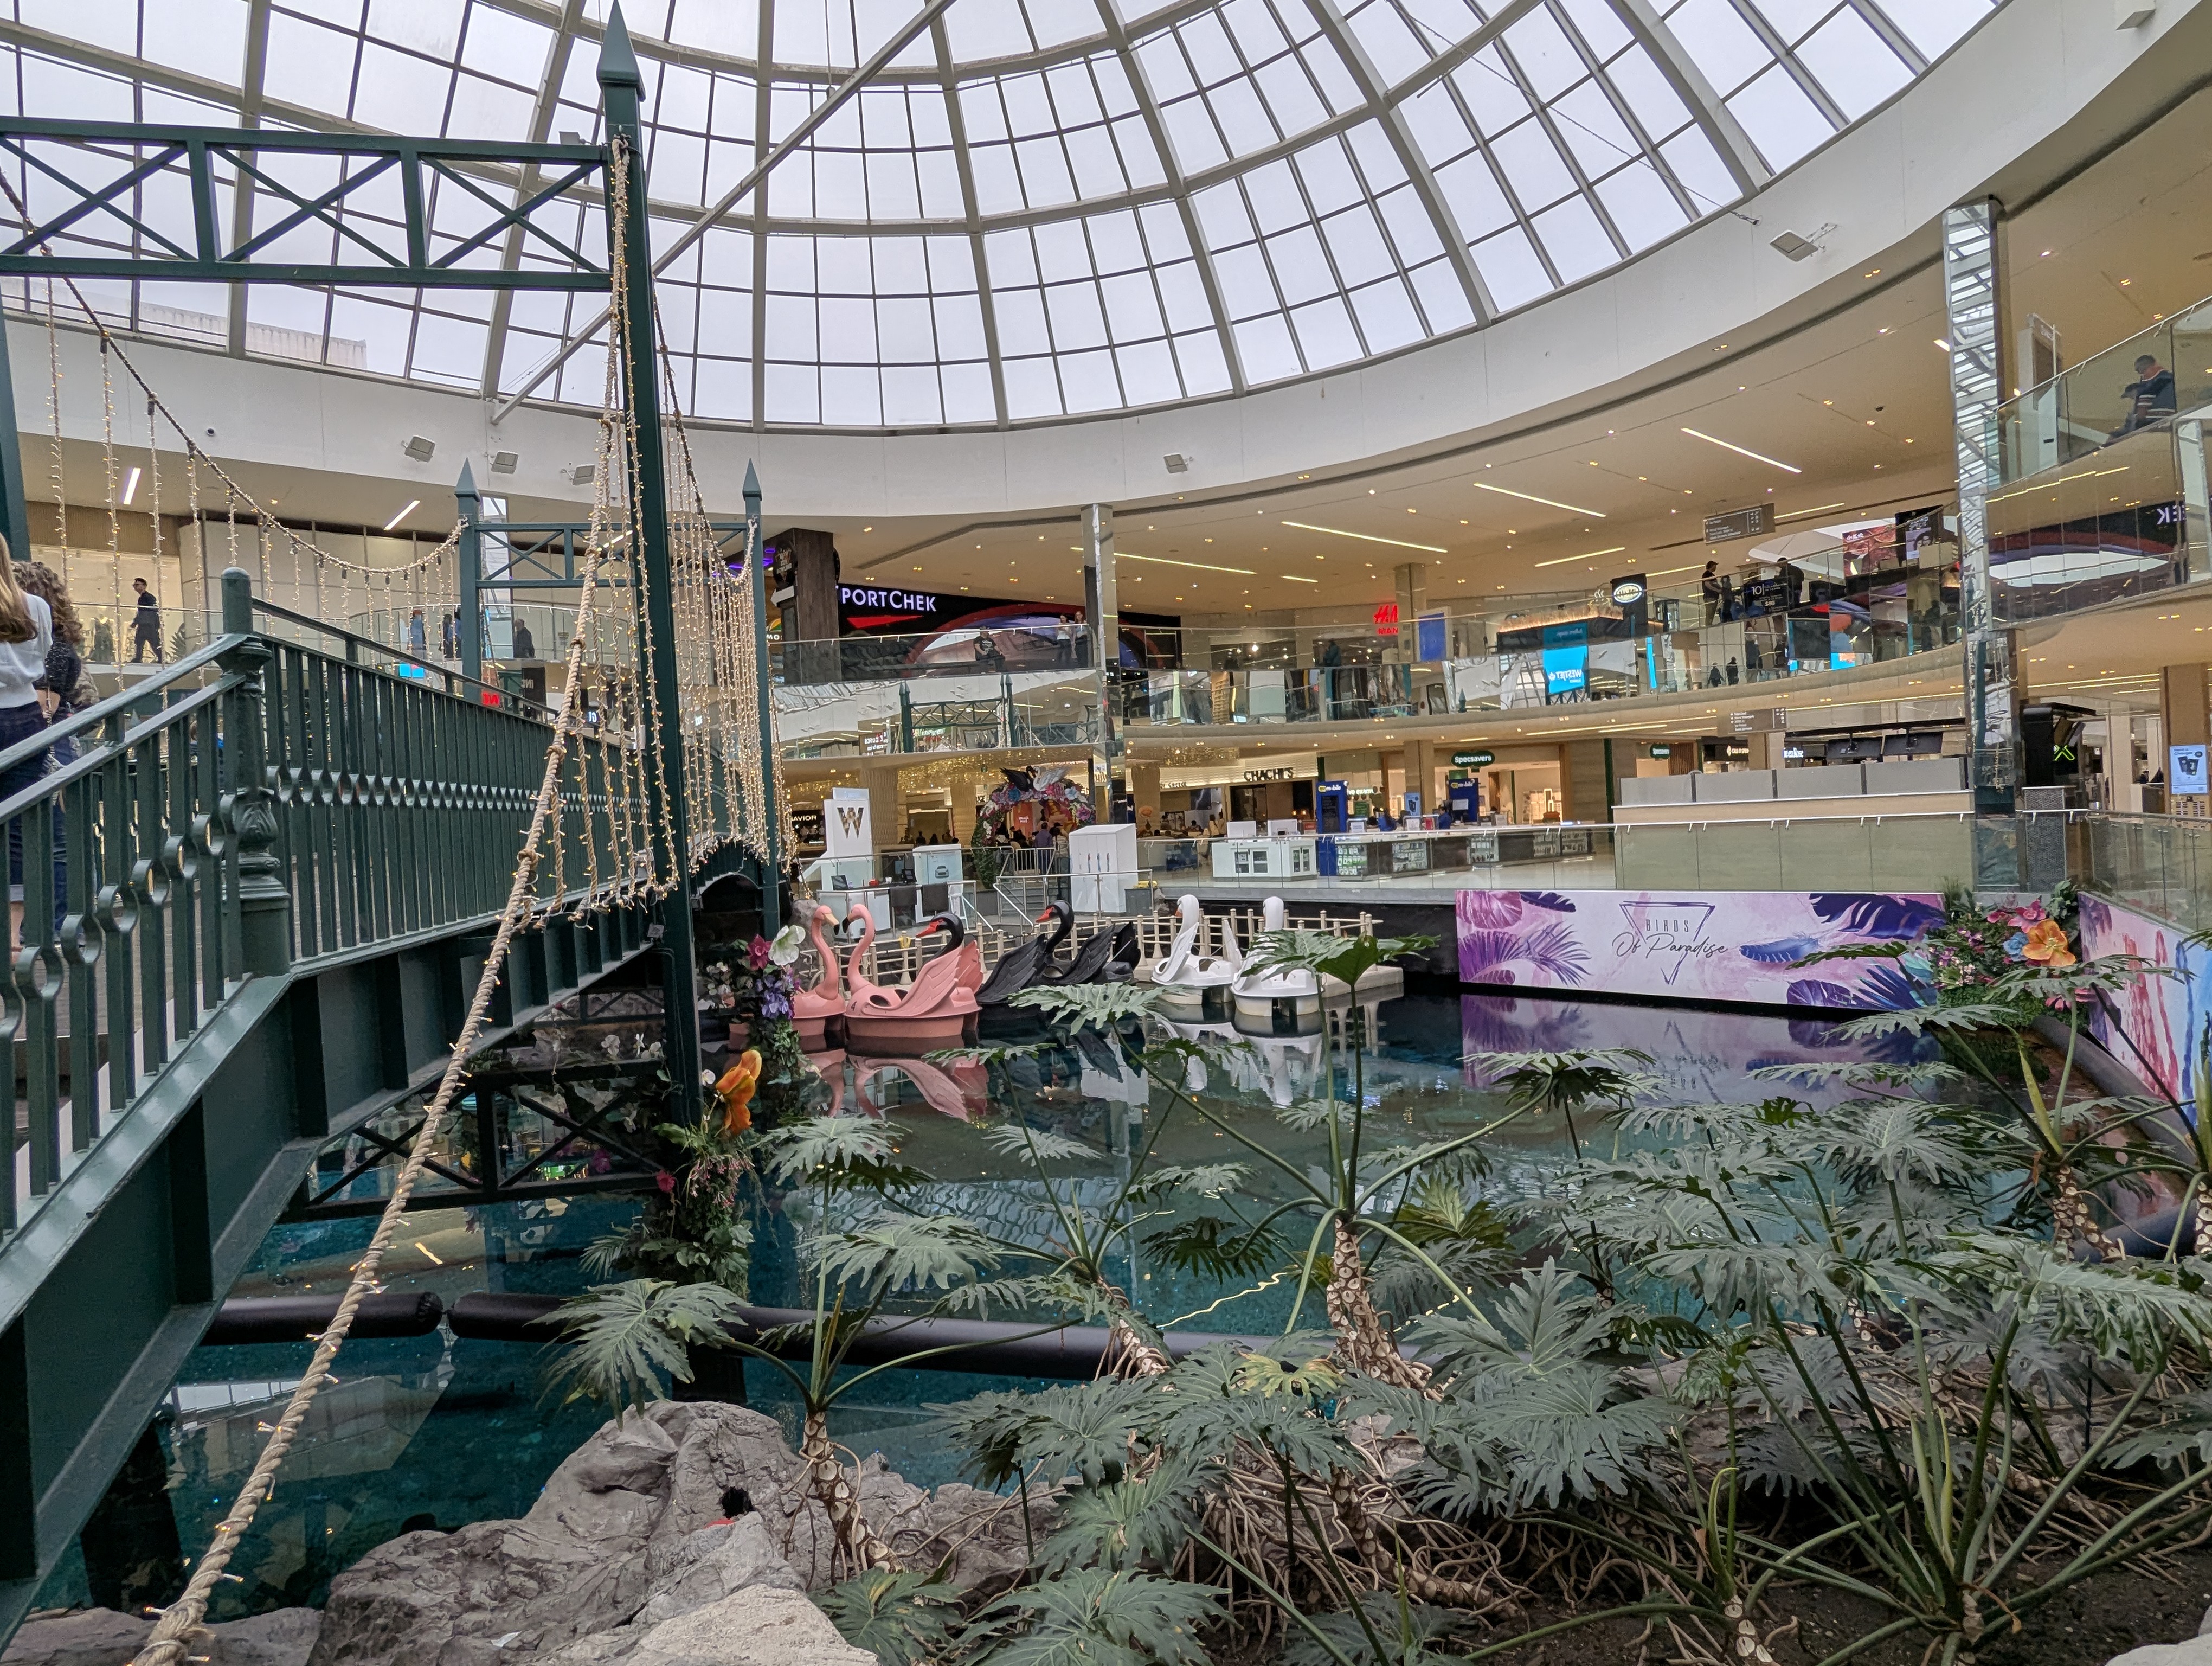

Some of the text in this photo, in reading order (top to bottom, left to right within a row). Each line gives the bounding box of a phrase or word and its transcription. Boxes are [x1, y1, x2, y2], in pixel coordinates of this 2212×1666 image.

[835, 585, 936, 612] PORTCHEK
[1455, 755, 1492, 764] Specsavers
[837, 807, 864, 839] W
[1646, 919, 1689, 932] BIRDS
[1612, 932, 1728, 959] Of Paradise
[851, 1001, 857, 1011] 4
